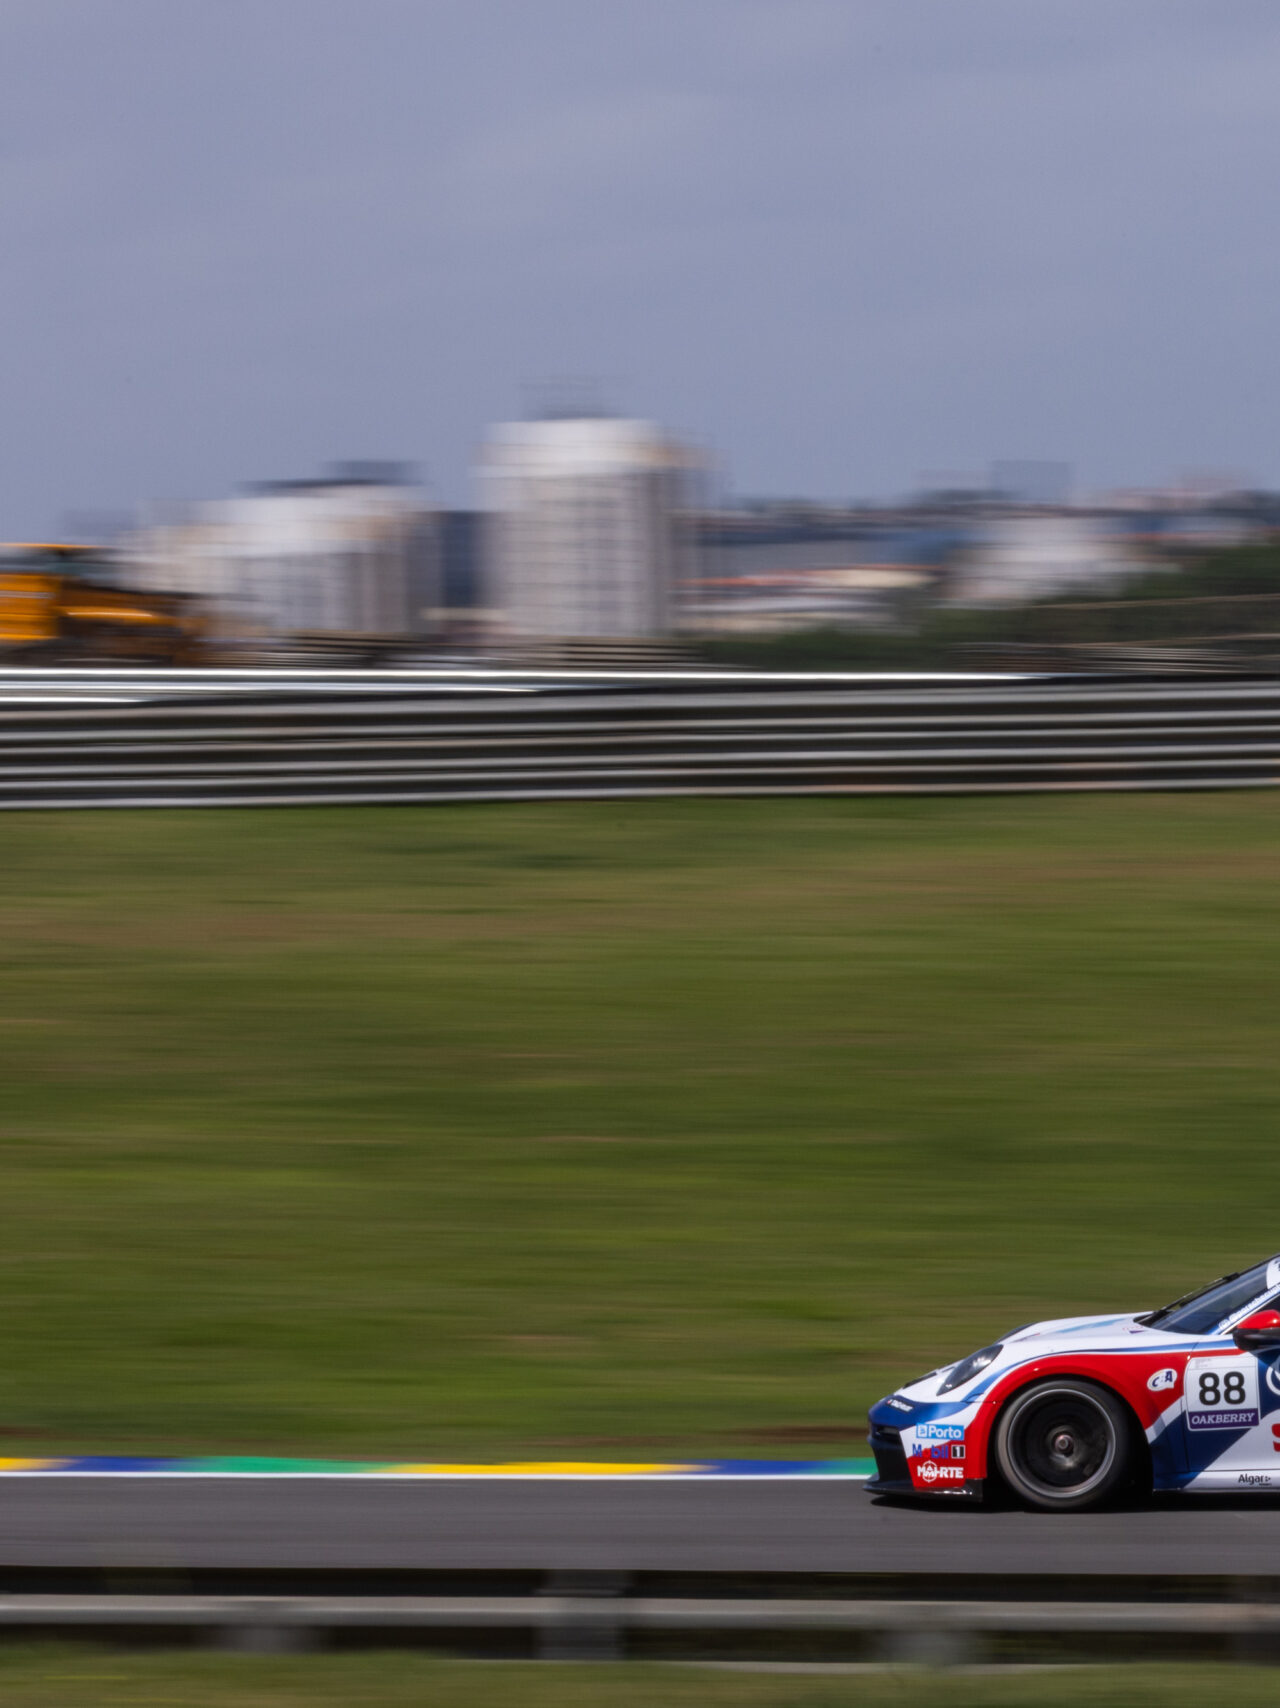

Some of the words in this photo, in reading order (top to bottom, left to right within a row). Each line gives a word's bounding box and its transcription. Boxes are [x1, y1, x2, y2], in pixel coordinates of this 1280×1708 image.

[1199, 1371, 1246, 1406] 88
[1192, 1412, 1255, 1425] OAKBERRY
[928, 1424, 962, 1438] Porto
[1238, 1474, 1264, 1485] Algar
